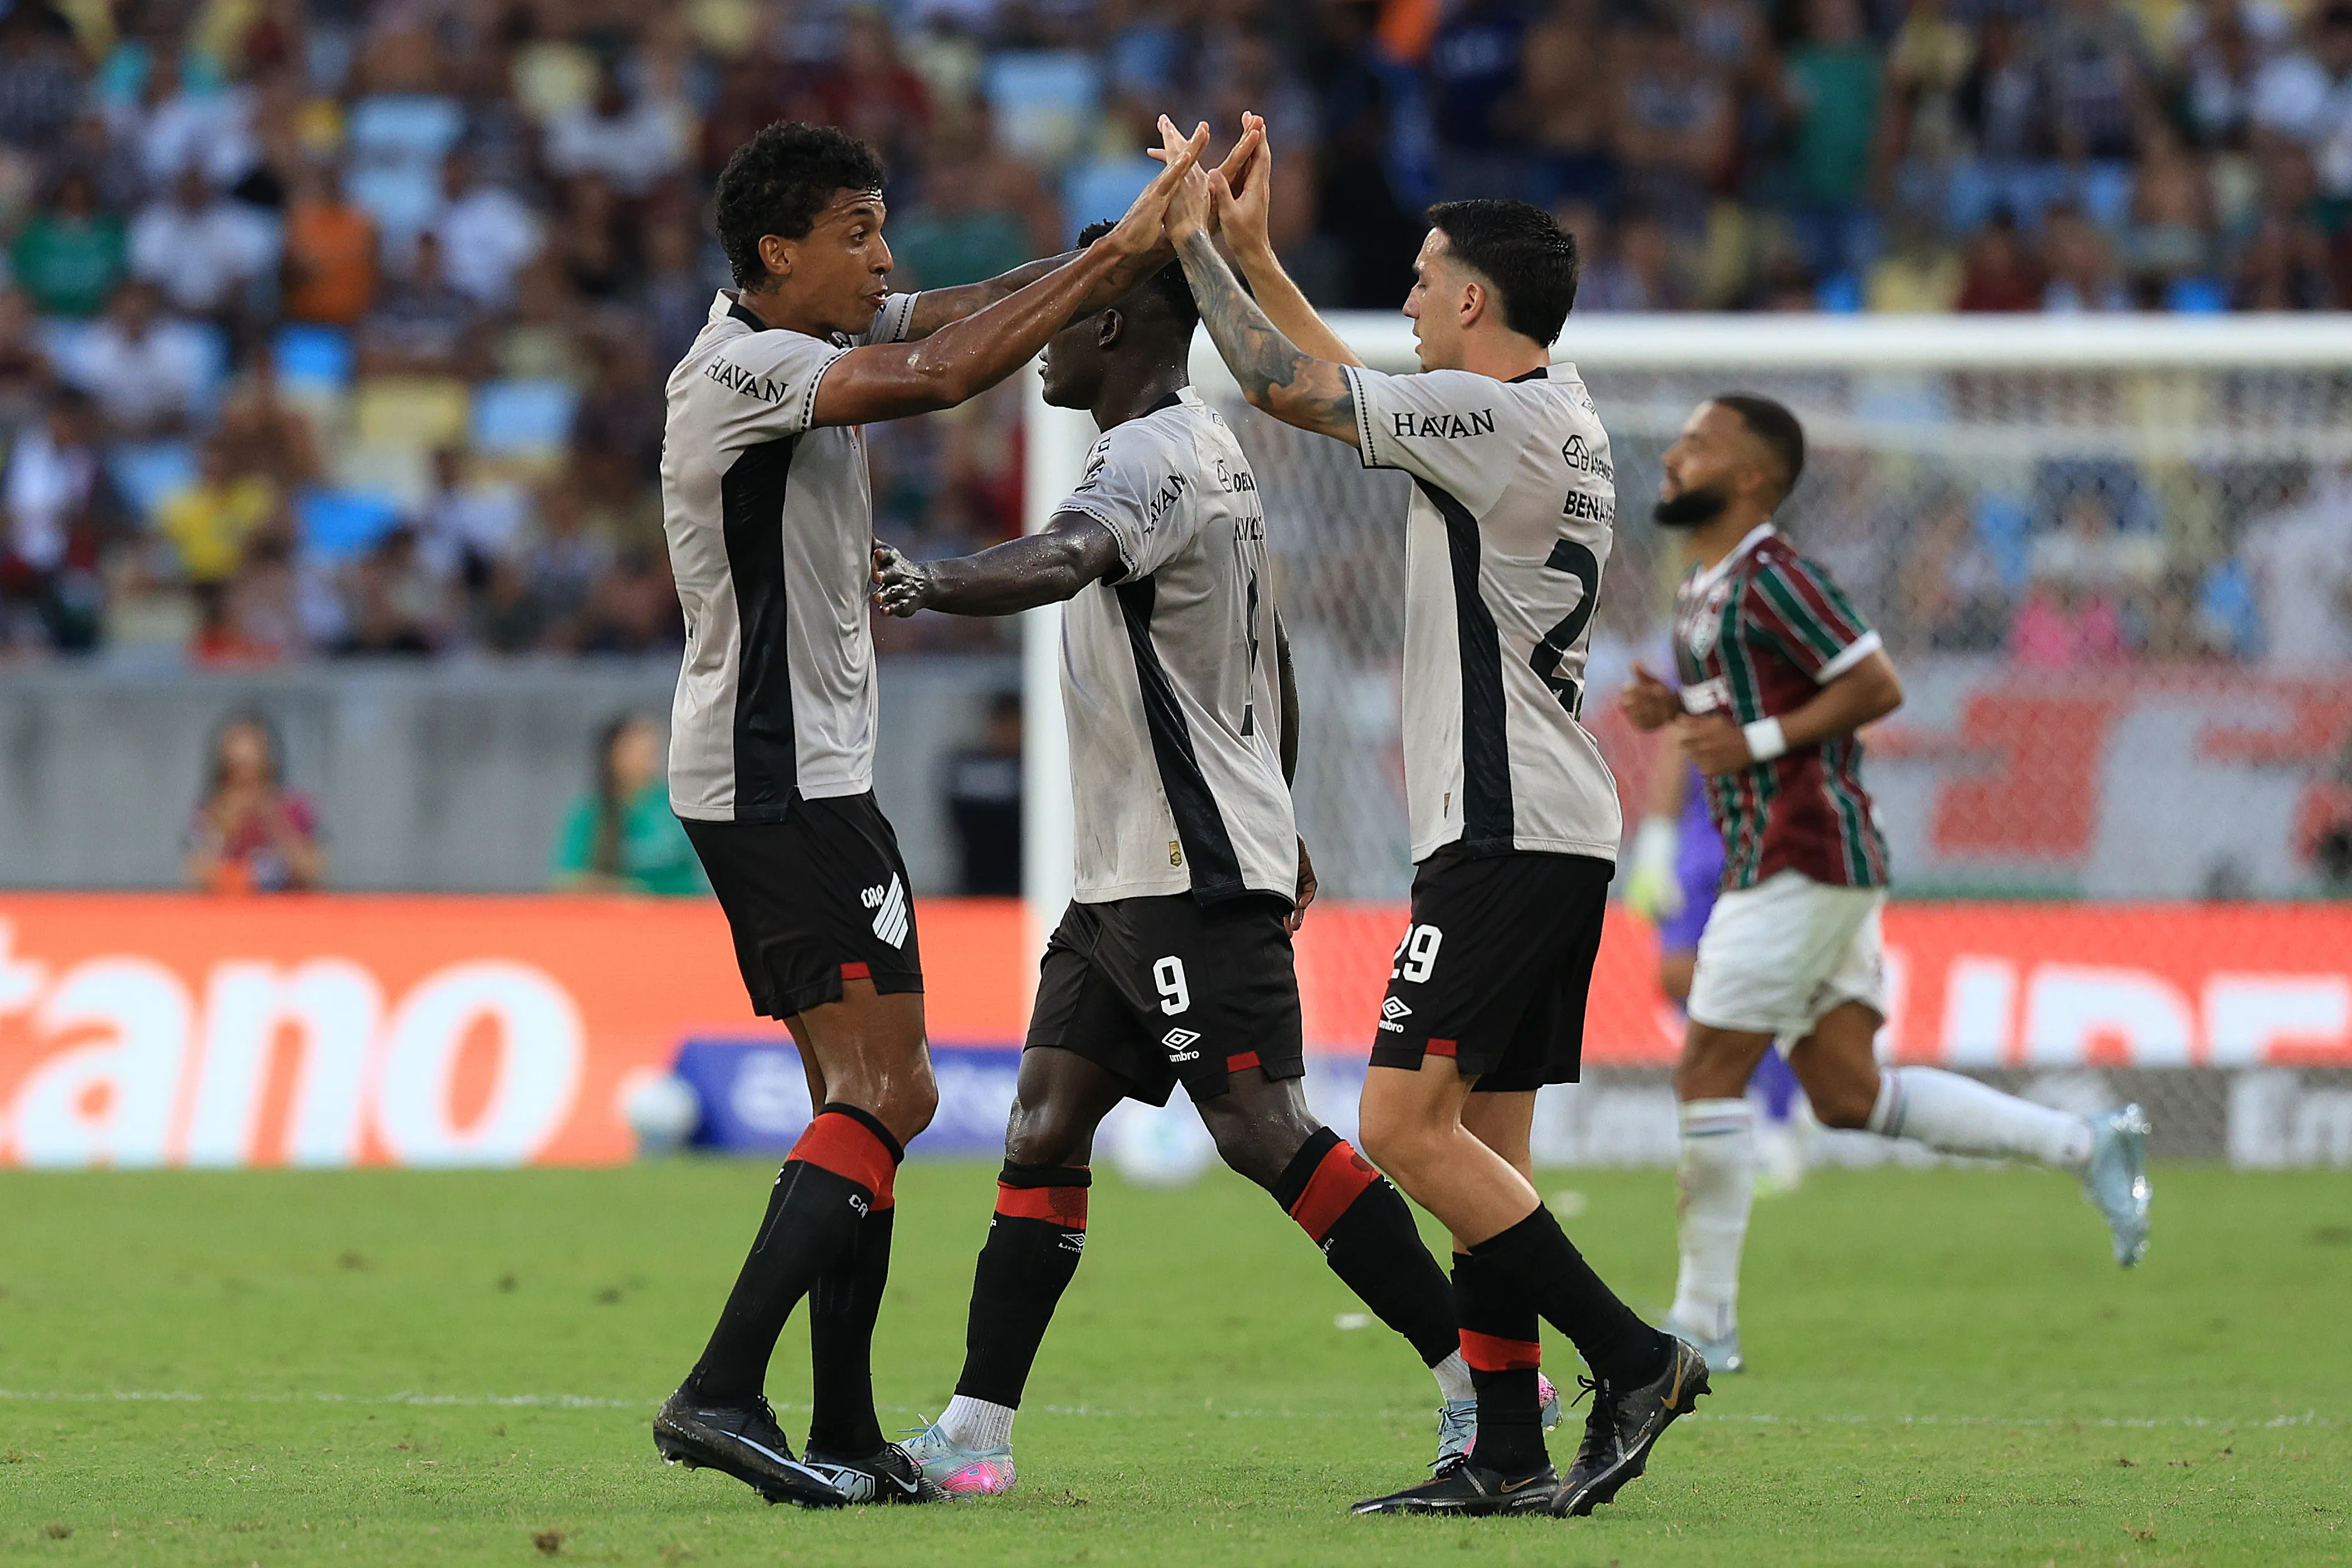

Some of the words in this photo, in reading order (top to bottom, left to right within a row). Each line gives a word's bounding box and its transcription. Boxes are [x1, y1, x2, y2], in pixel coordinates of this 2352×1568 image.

[704, 355, 789, 404] HAVAN
[1392, 408, 1495, 439] HAVAN
[1144, 466, 1185, 534] AVAN
[1529, 538, 1598, 721] 2
[861, 884, 885, 909] CAP
[1153, 956, 1190, 1016] 9
[1169, 1051, 1200, 1063] umbro
